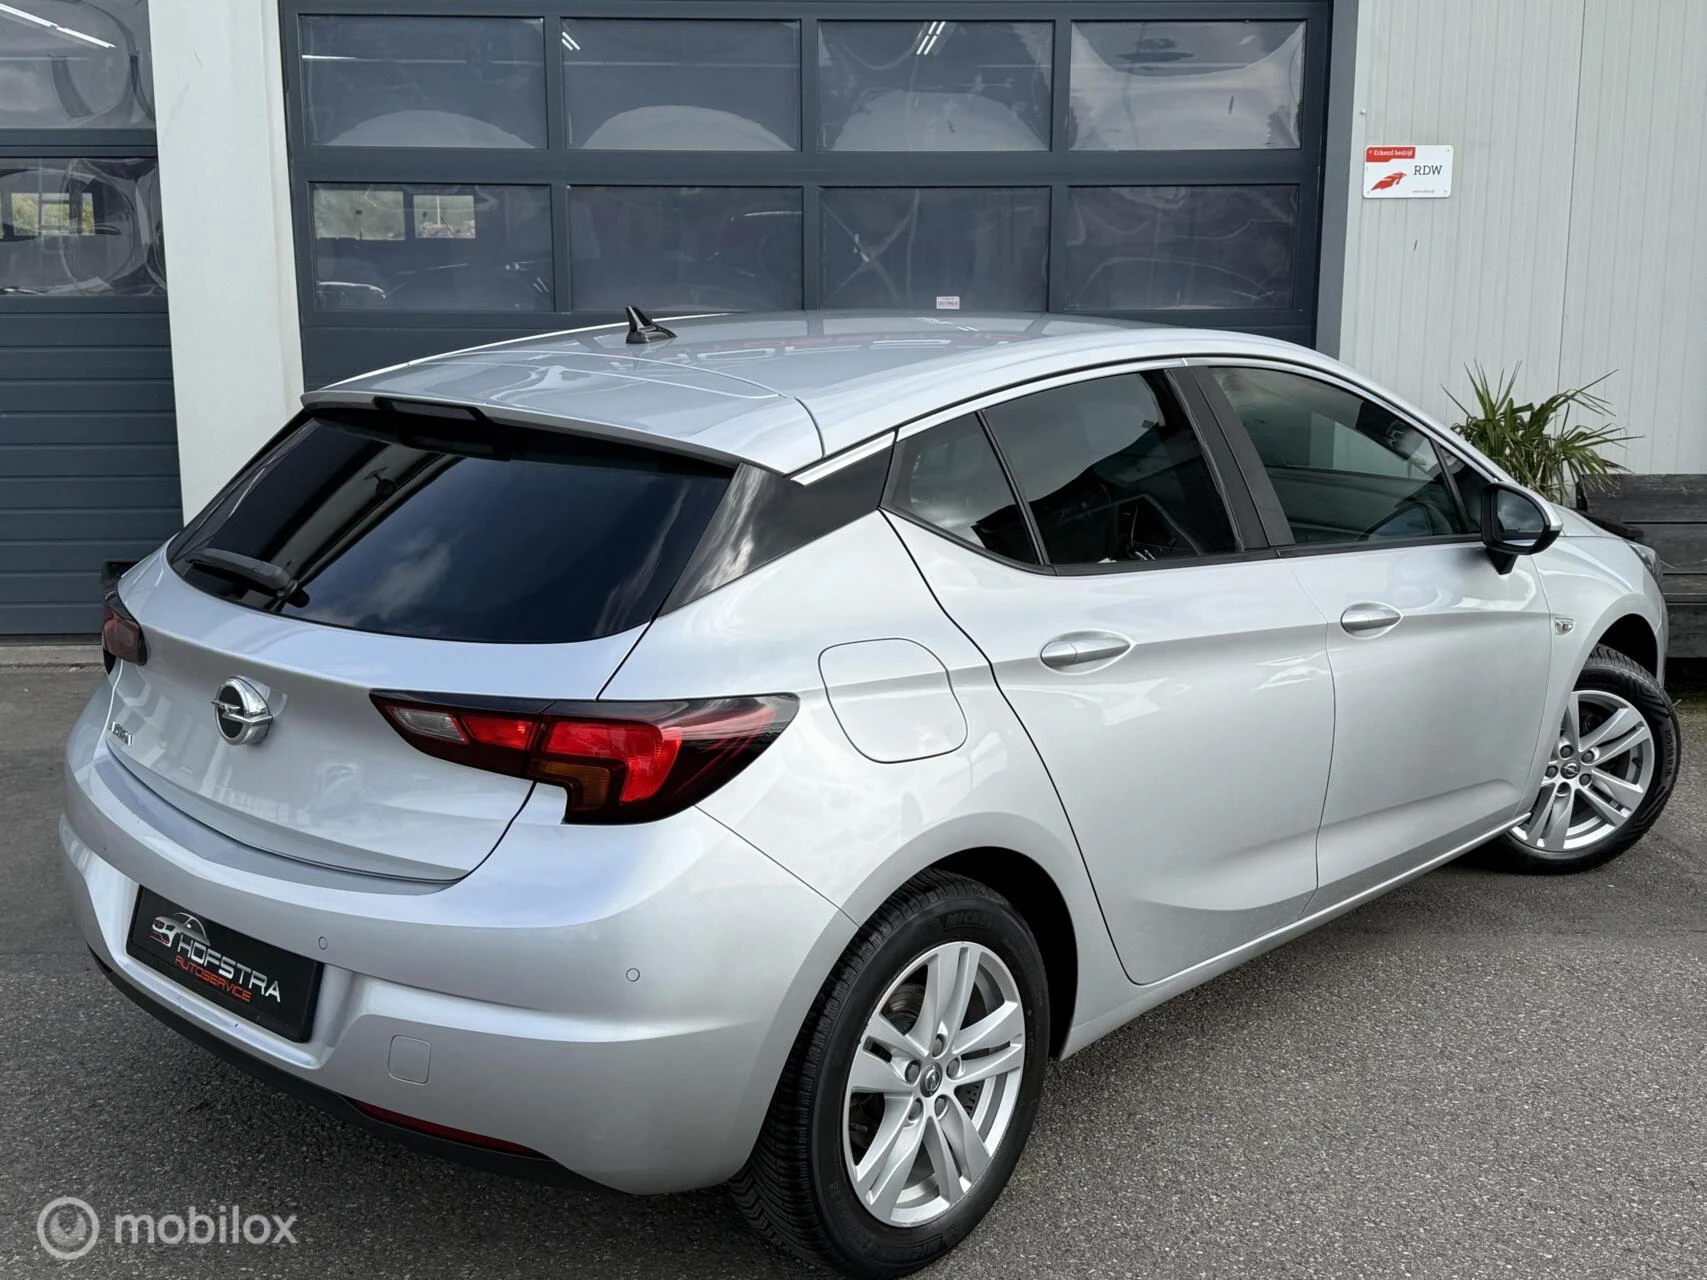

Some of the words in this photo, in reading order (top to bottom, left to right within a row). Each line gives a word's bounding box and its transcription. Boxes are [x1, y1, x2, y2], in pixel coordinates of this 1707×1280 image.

[1413, 165, 1443, 176] RDW
[175, 954, 253, 1003] AUTOSERVICE
[178, 934, 281, 1003] HOFSTRA
